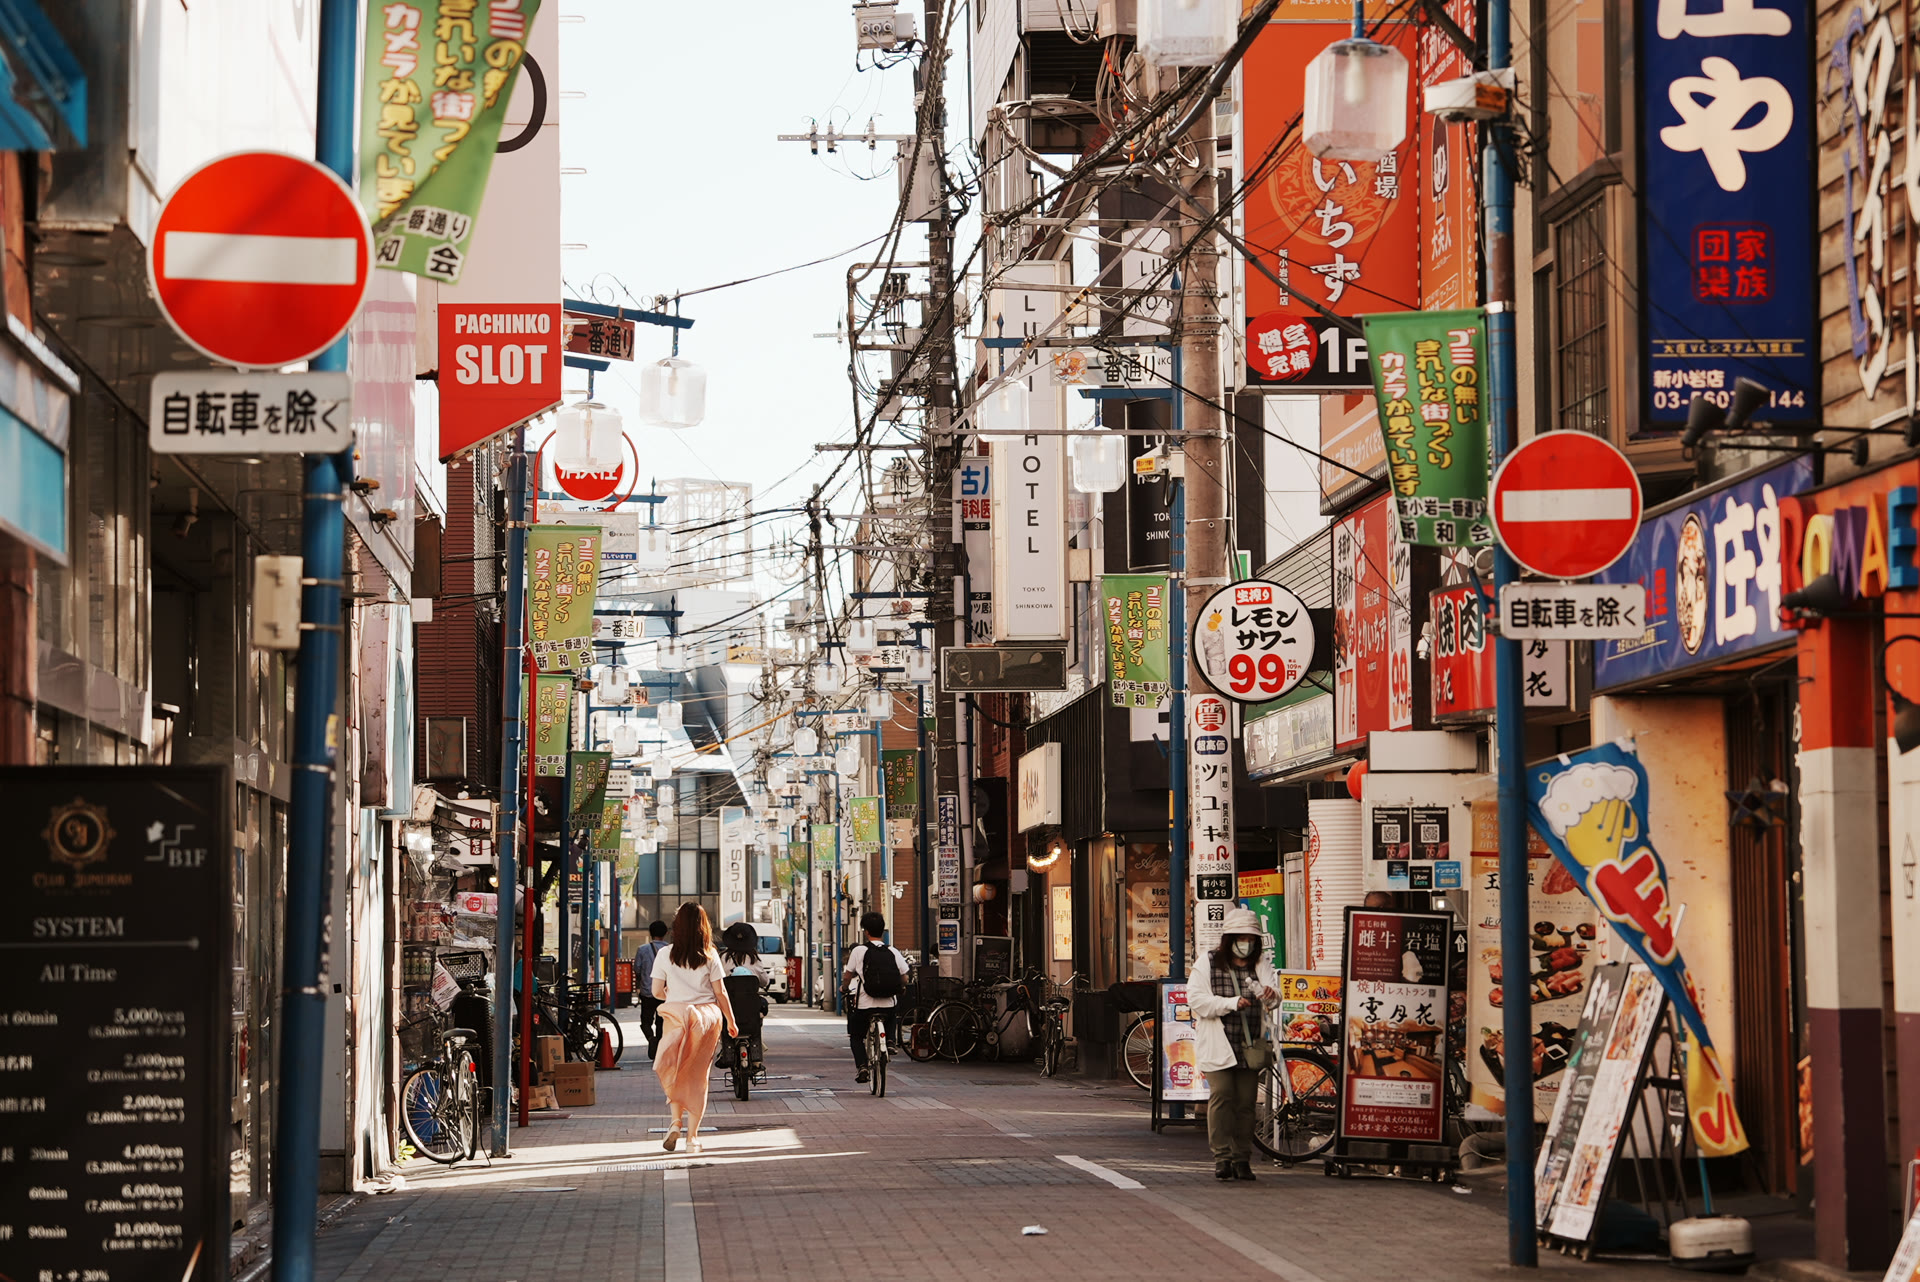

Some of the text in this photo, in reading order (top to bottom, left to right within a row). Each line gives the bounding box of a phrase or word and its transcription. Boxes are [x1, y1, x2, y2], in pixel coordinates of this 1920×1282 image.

[1310, 157, 1361, 303] いちず
[455, 313, 551, 334] PACHINKO
[573, 321, 634, 360] 一番通り
[455, 344, 548, 385] SLOT
[1447, 327, 1478, 424] ゴミの無い
[1653, 370, 1725, 388] 新小岩店
[163, 389, 338, 437] 自転車を除く
[1415, 339, 1453, 469] きれいな街づくり
[1378, 351, 1420, 496] カメラが見ています
[1023, 434, 1041, 554] HOTEL
[974, 523, 987, 531] 3F
[576, 537, 597, 597] ゴミの無い
[554, 541, 575, 624] きれいな街づくり
[532, 548, 552, 641] カメラが見ています
[1146, 585, 1163, 641] ゴミの無い
[1231, 606, 1299, 628] レモン
[1511, 598, 1637, 629] 自転車を除く
[602, 619, 645, 638] 一番通り
[1127, 591, 1145, 667] きれいな街づくり
[1437, 590, 1486, 659] 焼肉
[534, 636, 590, 654] 新小岩一番通り
[1107, 597, 1128, 679] カメラが見ています
[1236, 629, 1297, 651] サワー
[1228, 653, 1286, 694] 99
[1287, 669, 1297, 680] 円
[1113, 680, 1166, 693] 新小岩一番通り
[1196, 740, 1226, 752] 超高価
[1202, 762, 1221, 842] ツユキ
[168, 848, 207, 867] B1F
[1196, 862, 1232, 871] 3651-3453
[1202, 878, 1227, 888] 新小岩
[1203, 889, 1227, 898] 1-29
[33, 916, 124, 937] SYSTEM
[1358, 929, 1397, 949] 雌牛
[1405, 931, 1441, 951] 岩塩
[40, 964, 118, 982] All Time
[12, 1011, 58, 1026] 60min
[114, 1008, 185, 1028] 5,000yen
[1319, 1003, 1337, 1013] 280
[124, 1053, 185, 1069] 2,000yen
[123, 1094, 184, 1111] 2,000yen
[123, 1144, 184, 1161] 4,000yen
[29, 1184, 183, 1200] 60min 6,000yen
[28, 1221, 183, 1239] 90min 10,000yen
